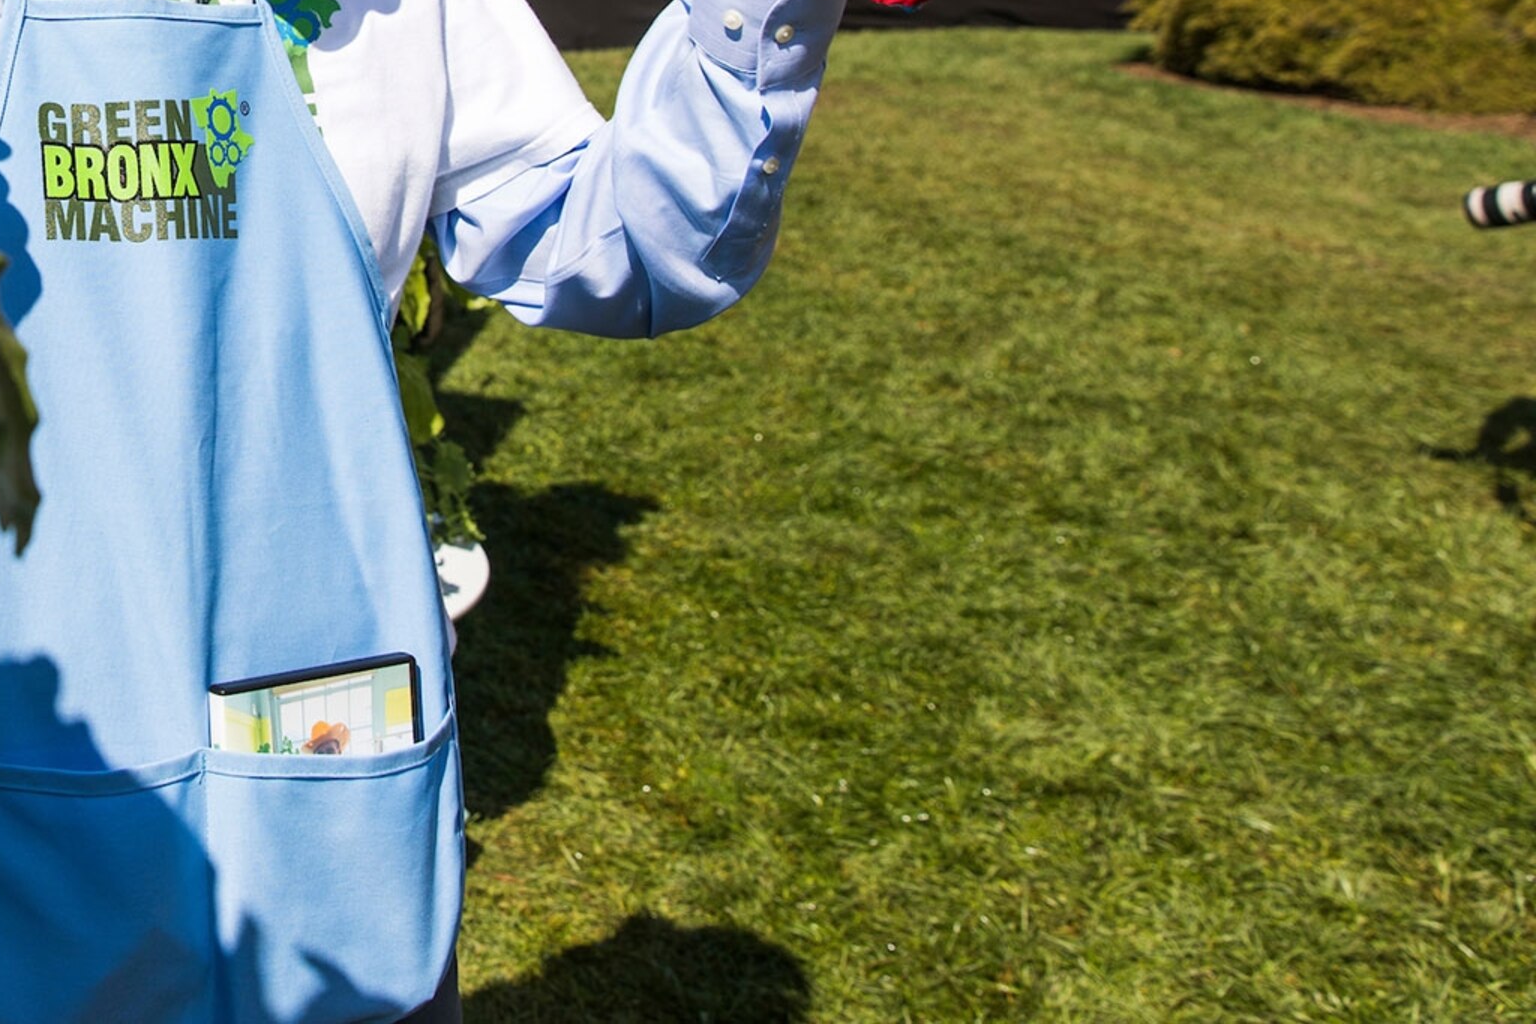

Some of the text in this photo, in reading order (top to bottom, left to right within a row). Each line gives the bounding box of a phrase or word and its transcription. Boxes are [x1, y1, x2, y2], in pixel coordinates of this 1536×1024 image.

[38, 98, 192, 145] GREEN
[42, 141, 200, 201] BRONX
[45, 195, 238, 243] MACHINE
